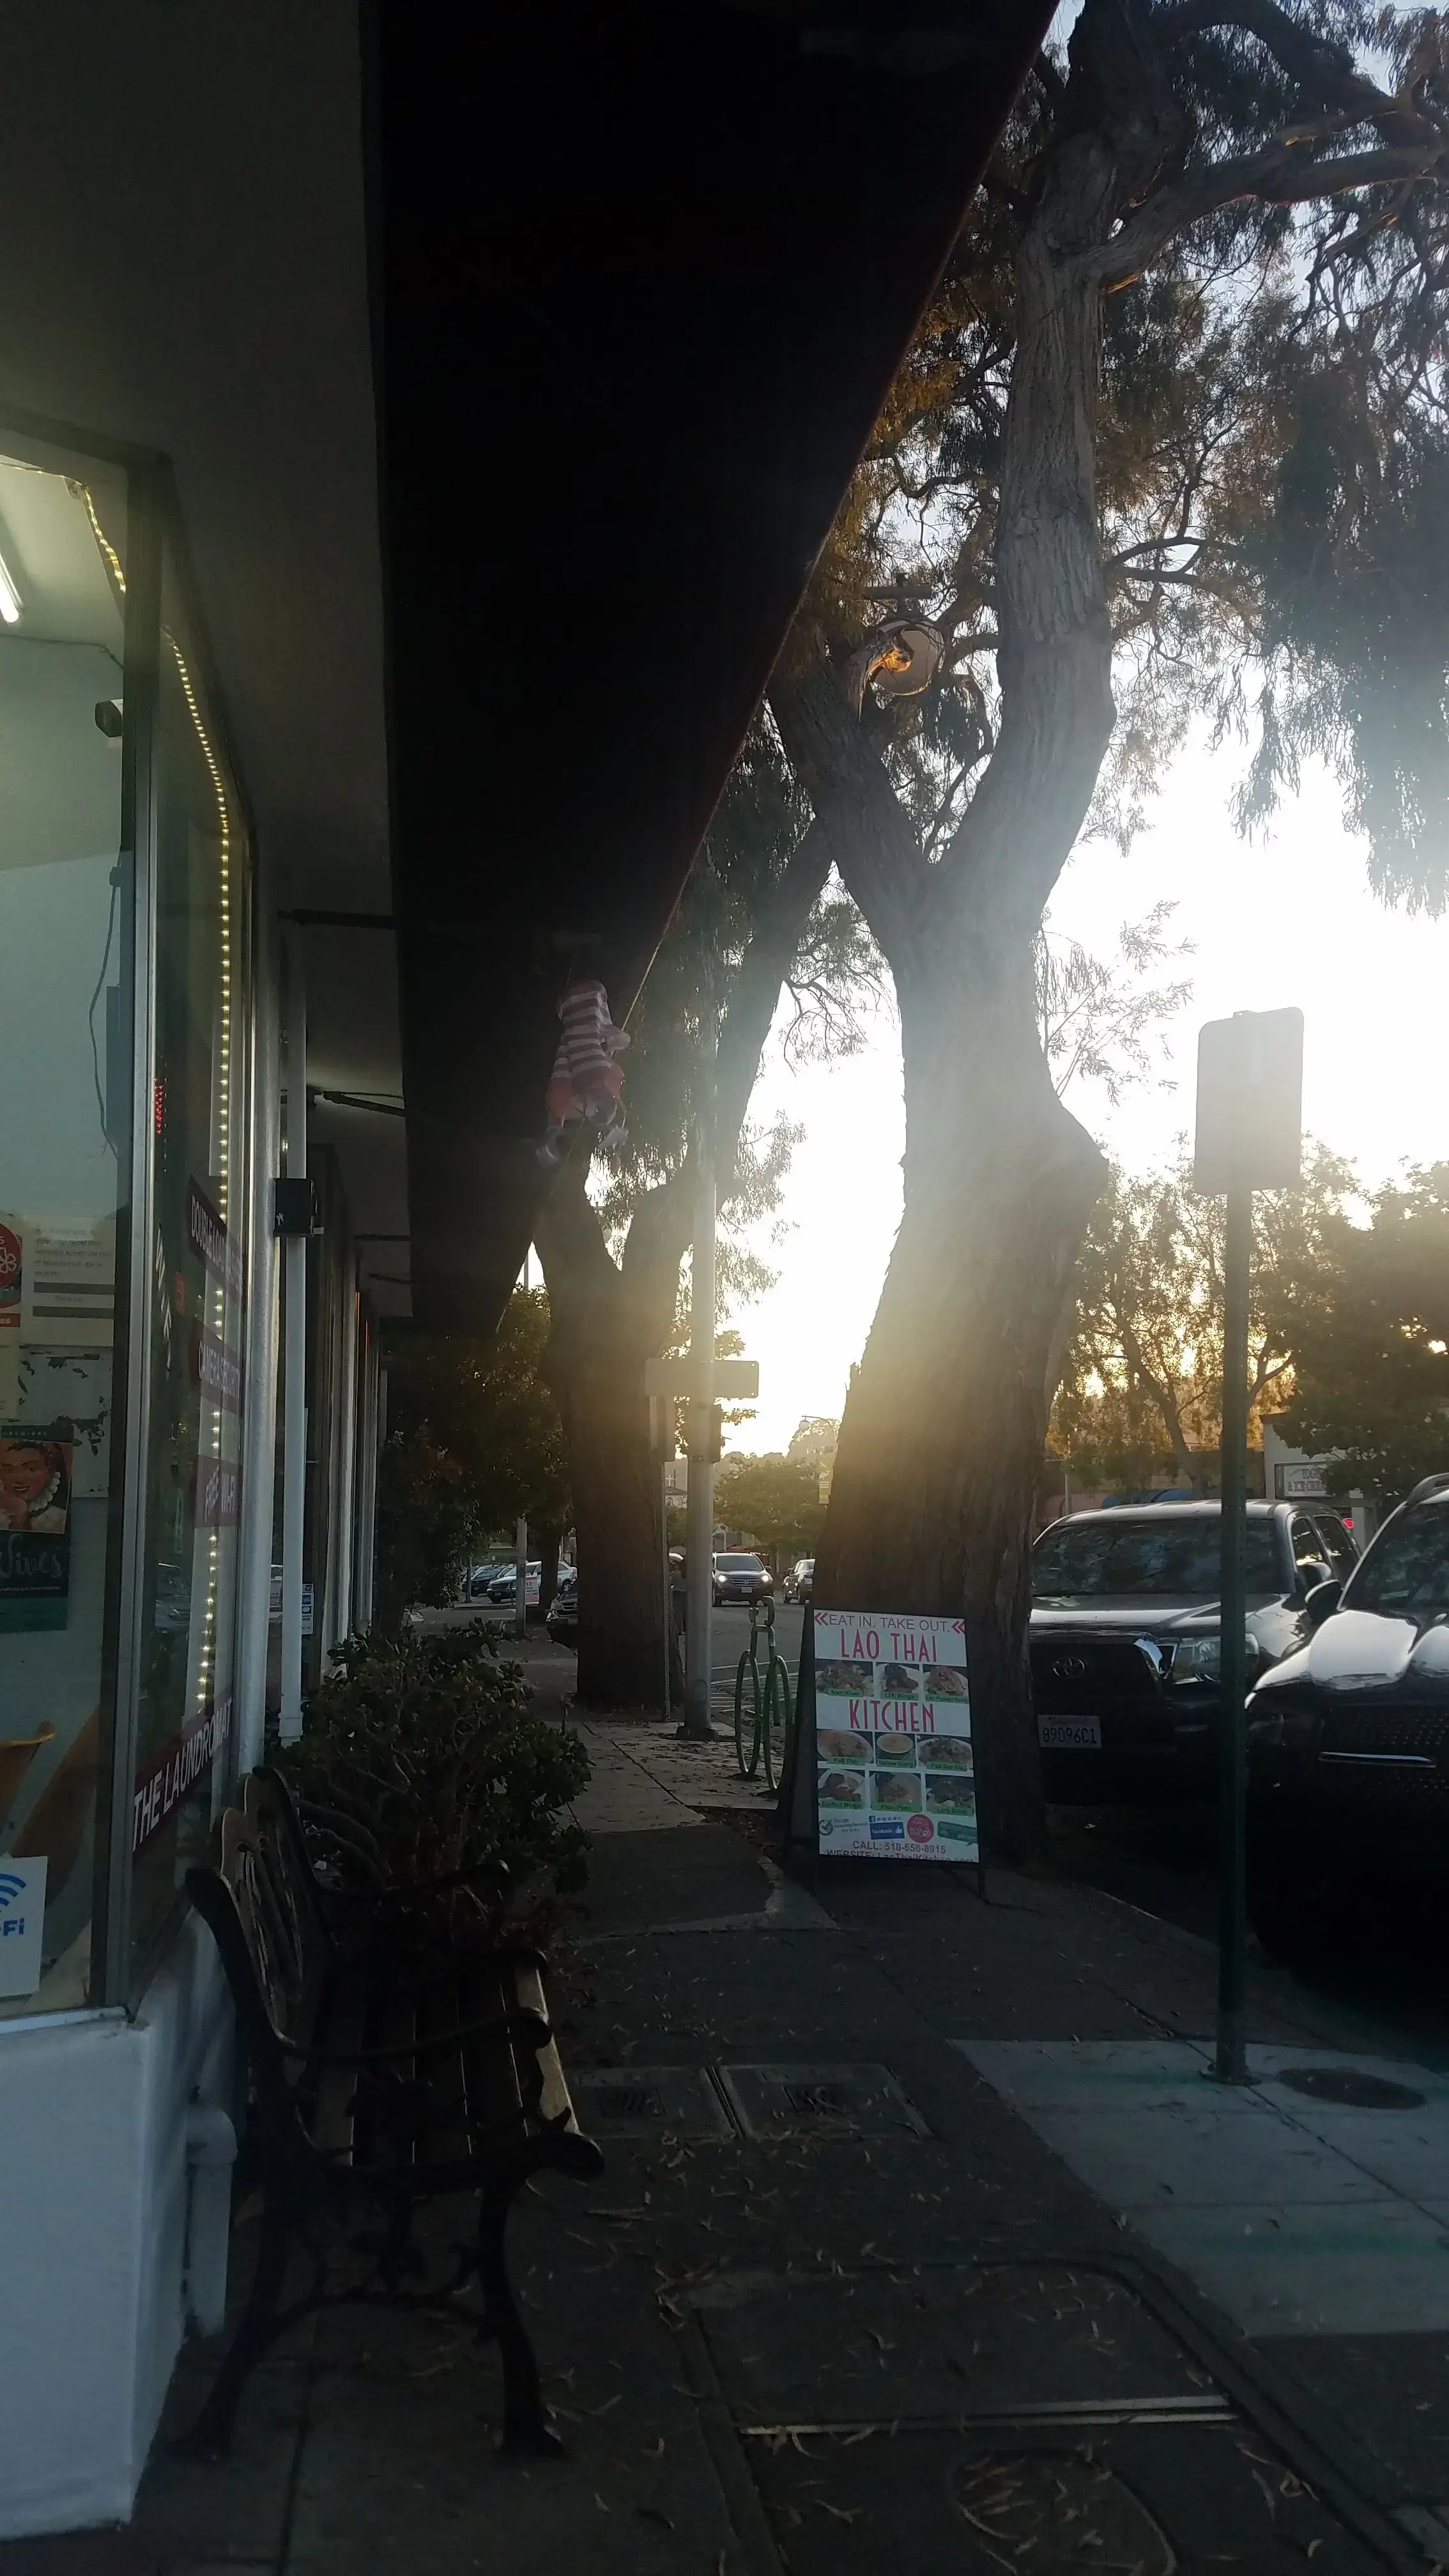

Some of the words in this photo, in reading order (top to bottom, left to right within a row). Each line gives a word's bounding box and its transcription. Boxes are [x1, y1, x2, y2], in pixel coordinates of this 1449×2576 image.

[192, 1195, 212, 1259] DOUBLE
[829, 1614, 855, 1627] EAT
[859, 1616, 876, 1629] IN.
[880, 1617, 916, 1630] TAKE
[919, 1620, 951, 1633] OUT.
[840, 1629, 880, 1660] LAO
[890, 1632, 938, 1662] THAI
[848, 1698, 936, 1733] KITCHEN
[1043, 1727, 1097, 1744] 89096C1
[132, 1769, 162, 1852] THE
[164, 1697, 232, 1814] LAUNDROMAT
[853, 1840, 882, 1851] CALL:
[884, 1843, 946, 1853] 510-558-8915
[0, 1918, 24, 1936] Fi
